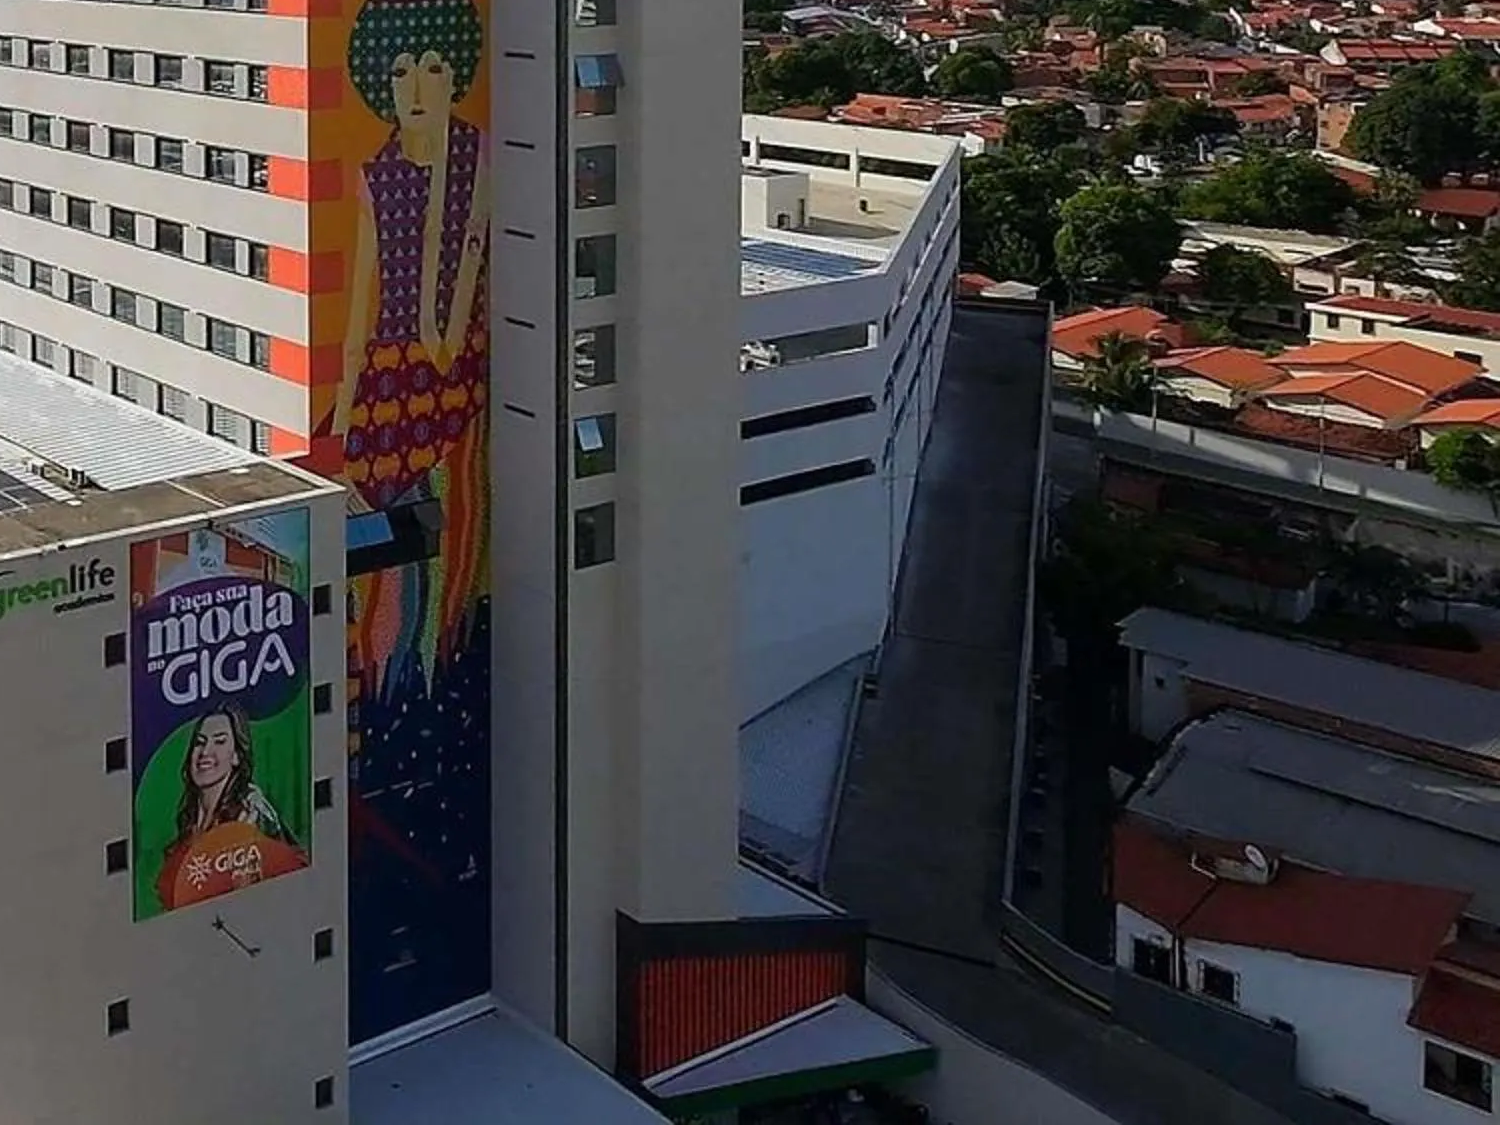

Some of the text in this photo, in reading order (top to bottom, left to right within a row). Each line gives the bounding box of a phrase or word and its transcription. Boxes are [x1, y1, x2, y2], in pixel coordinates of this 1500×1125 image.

[147, 585, 294, 658] moda
[169, 584, 248, 614] Faça sua
[162, 632, 296, 706] GIGA
[215, 844, 262, 873] GIGA
